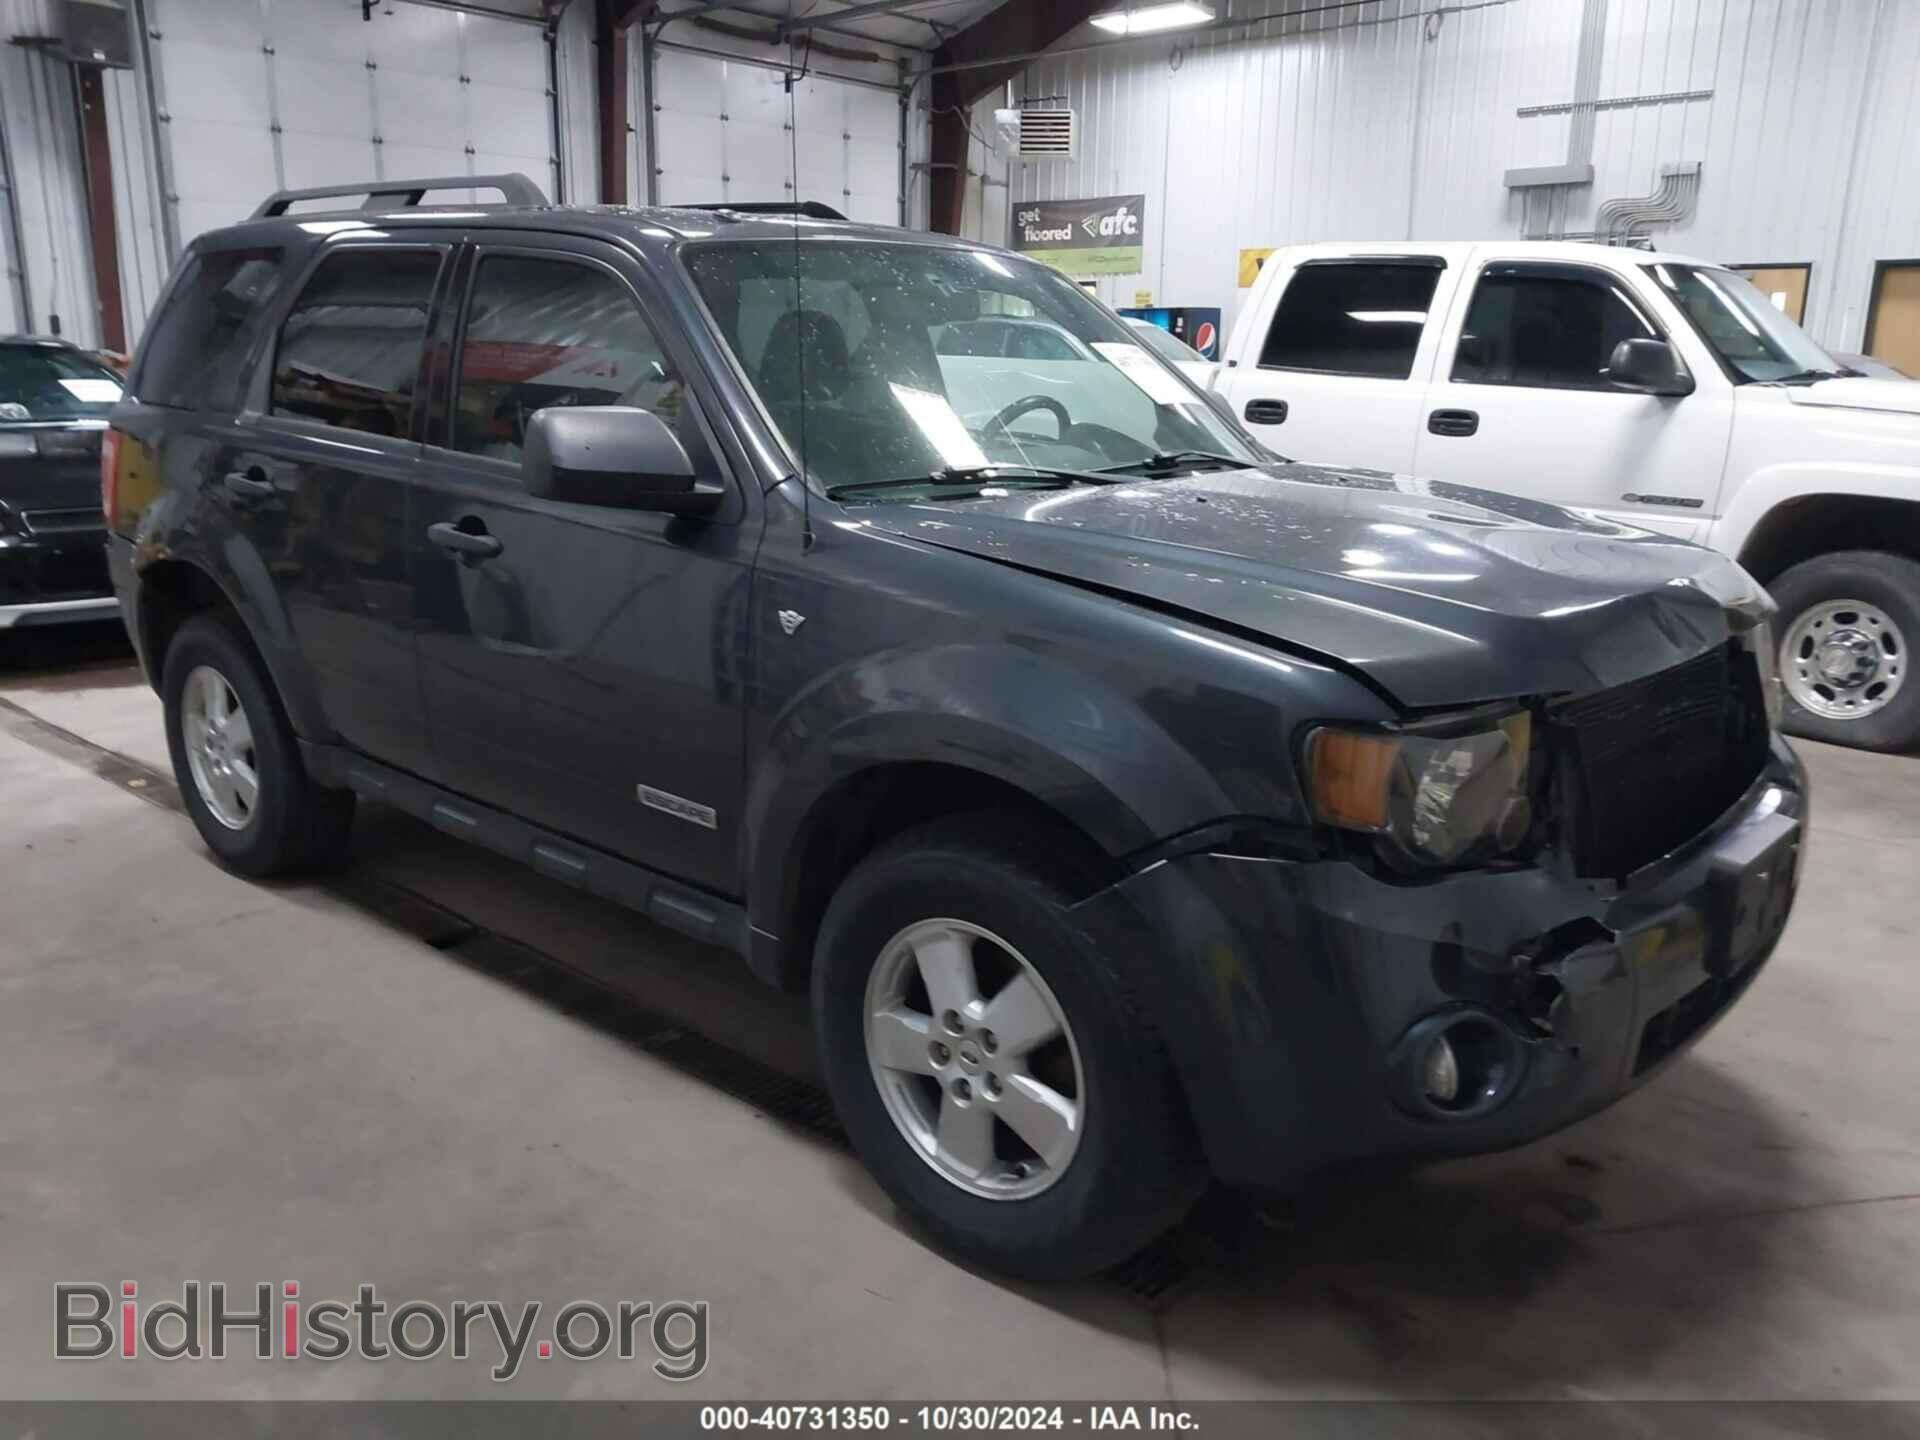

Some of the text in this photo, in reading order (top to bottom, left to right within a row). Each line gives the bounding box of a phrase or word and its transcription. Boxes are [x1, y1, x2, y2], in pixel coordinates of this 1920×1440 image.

[1018, 208, 1040, 226] get
[1100, 206, 1137, 236] afc
[1024, 223, 1072, 242] floored
